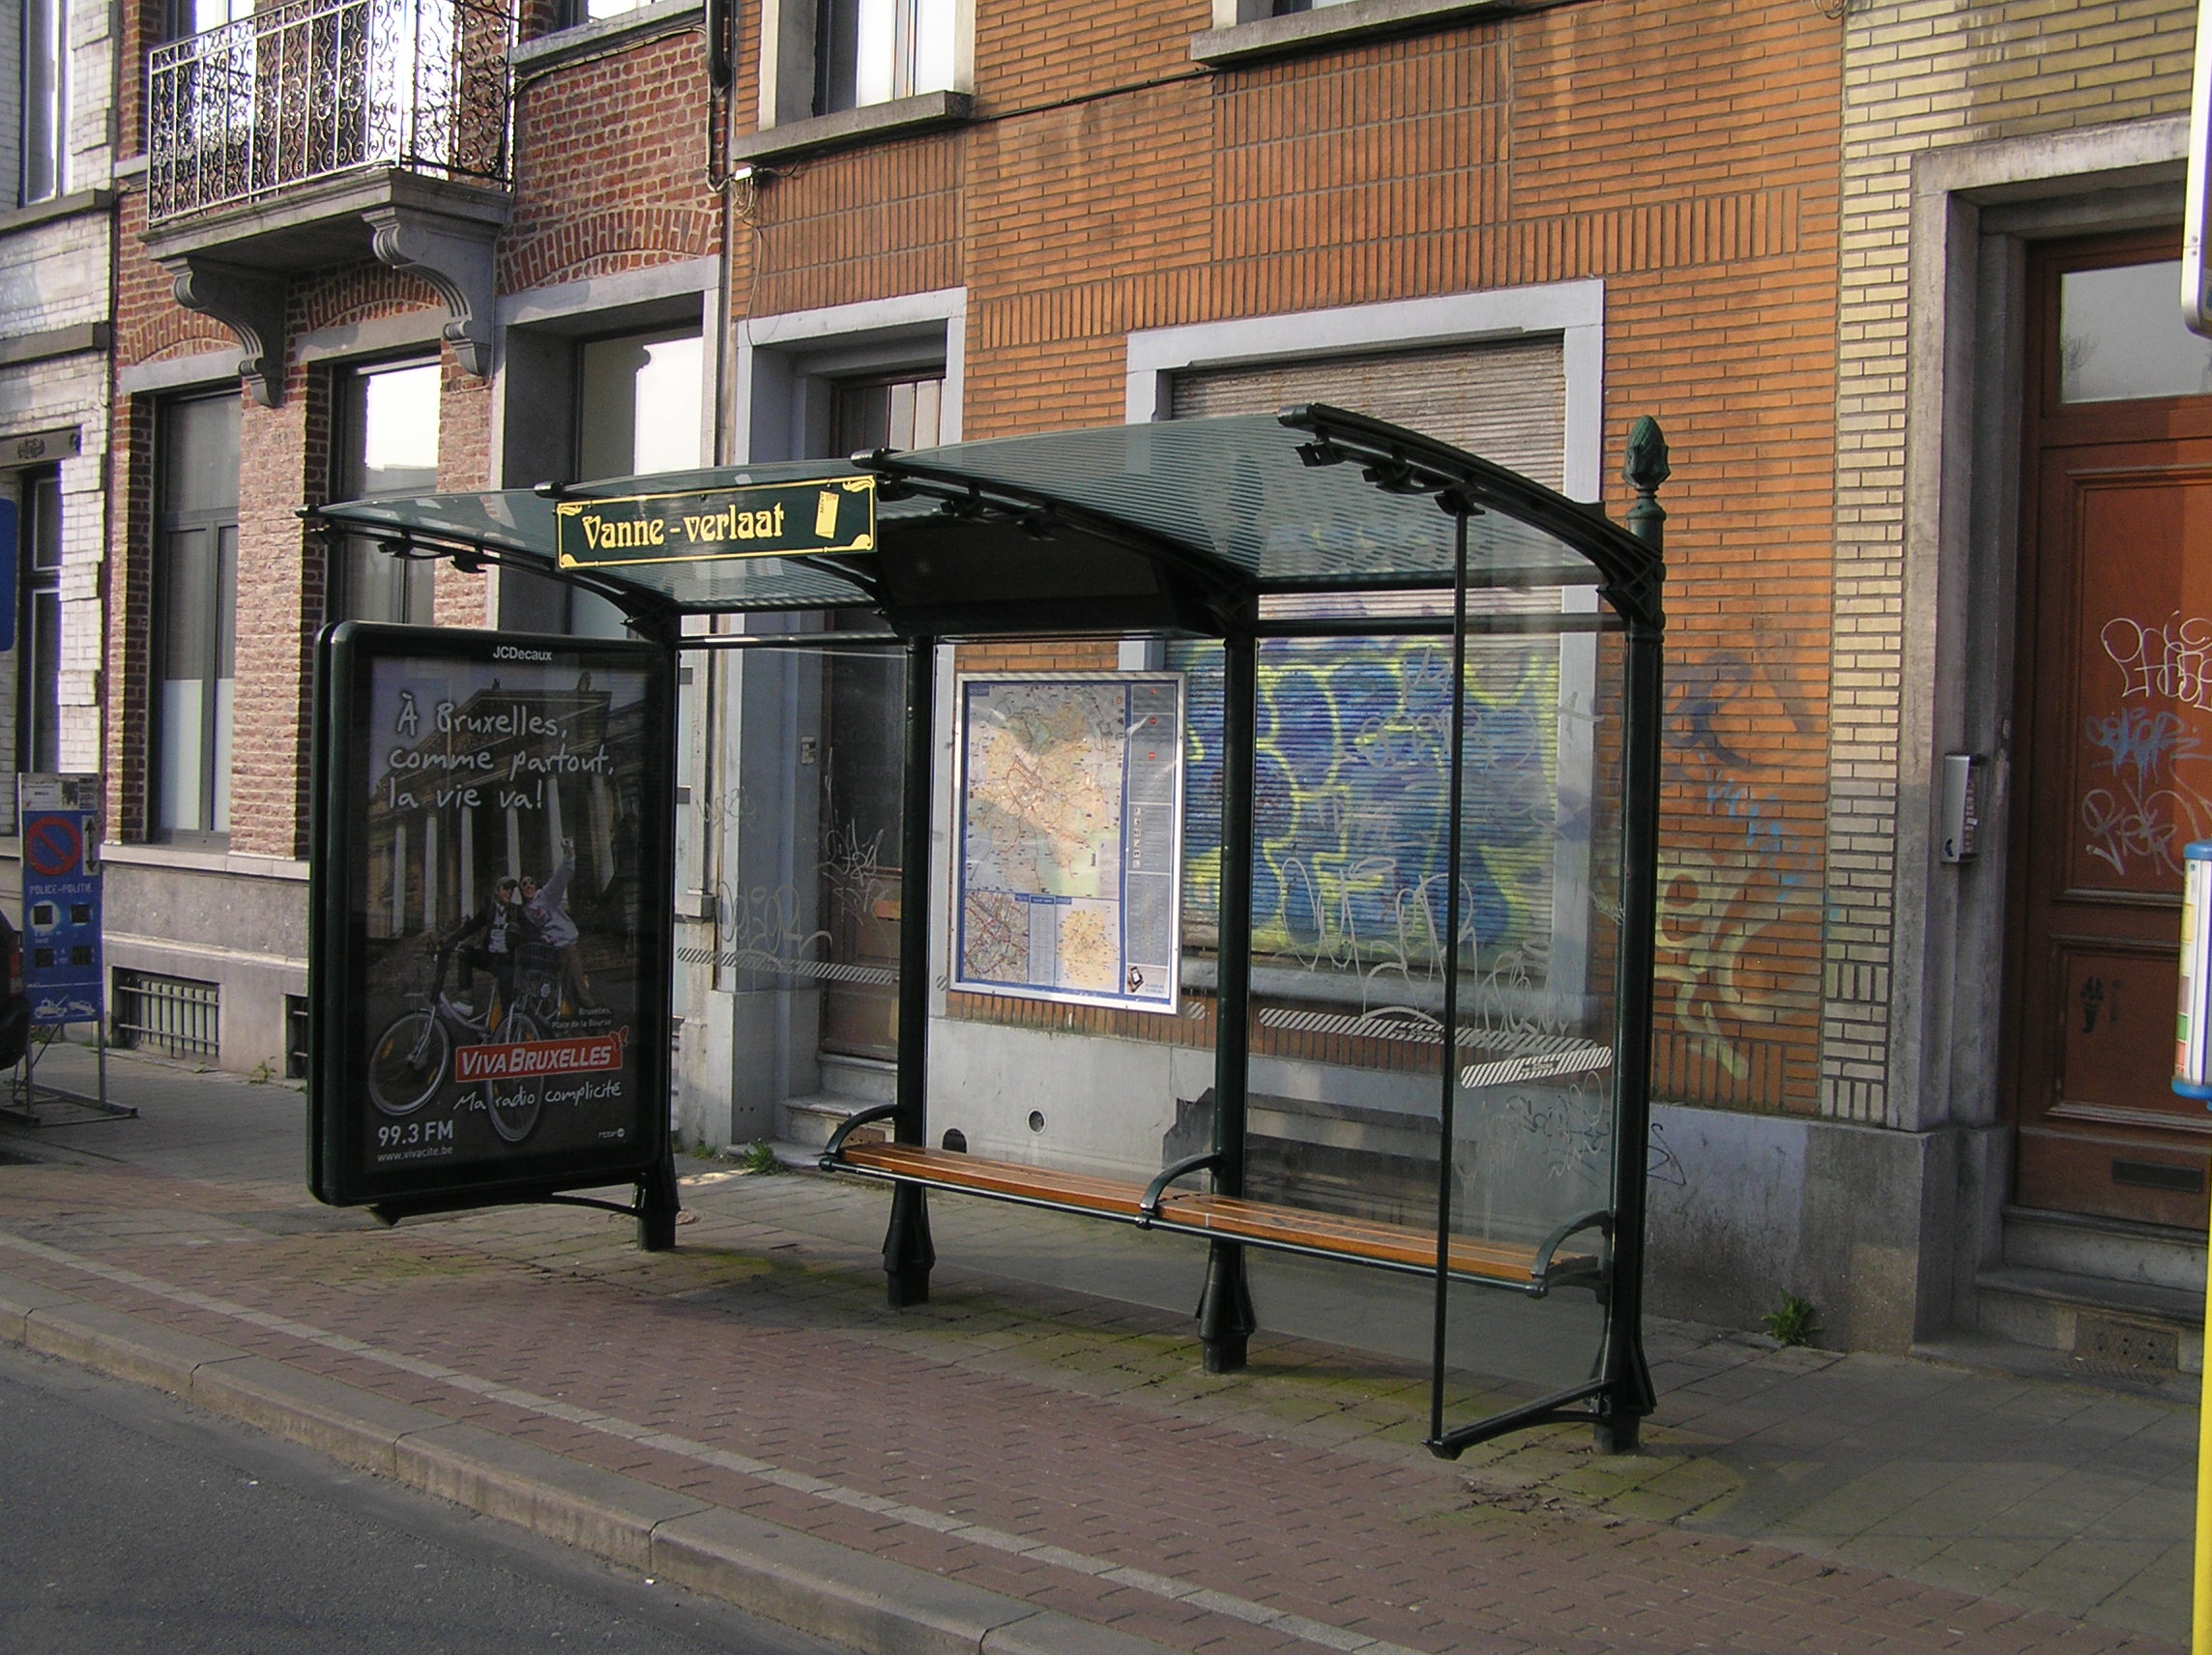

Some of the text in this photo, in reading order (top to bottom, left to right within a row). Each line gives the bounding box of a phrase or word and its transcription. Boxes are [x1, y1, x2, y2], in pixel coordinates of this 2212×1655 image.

[492, 646, 553, 662] JCDecaux
[396, 692, 568, 740] À Bruxelles,
[389, 742, 615, 782] comme partout,
[389, 776, 542, 810] la vie va!
[551, 1020, 569, 1030] Place
[571, 1019, 579, 1029] de
[452, 1079, 623, 1112] Ma radio complicité
[377, 1119, 454, 1147] 99.3 FM
[376, 1145, 454, 1163] www.vivacite.be
